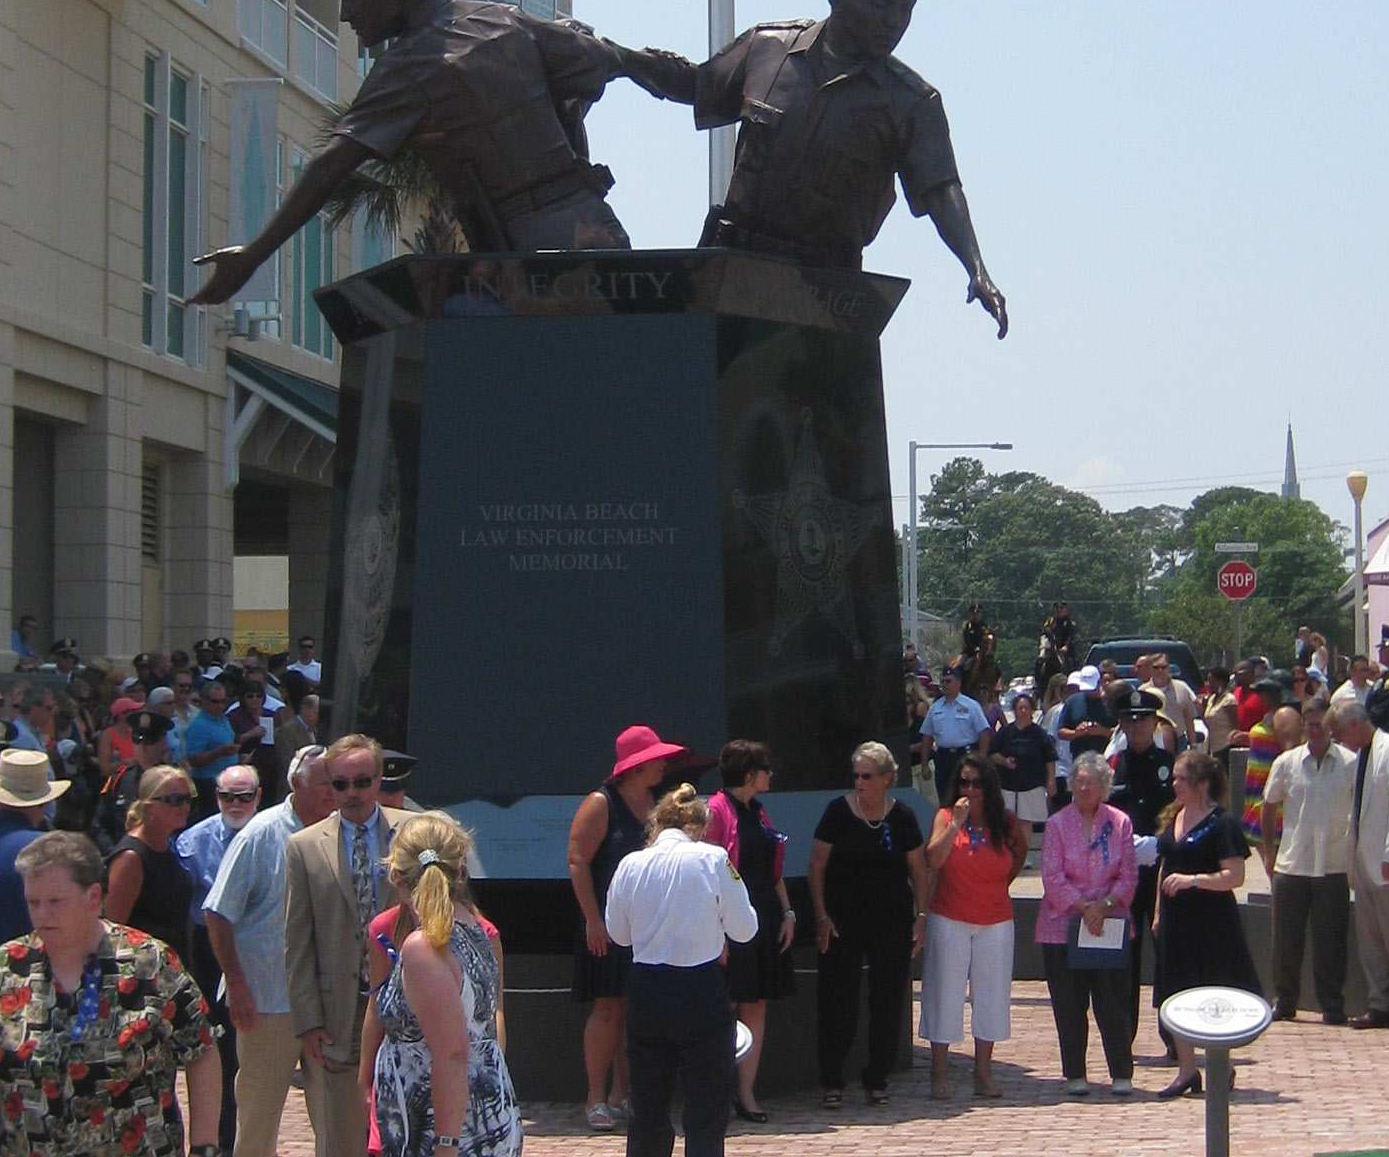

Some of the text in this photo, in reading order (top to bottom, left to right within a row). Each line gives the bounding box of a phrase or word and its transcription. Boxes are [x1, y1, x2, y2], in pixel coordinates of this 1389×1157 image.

[462, 270, 674, 301] INTEGRITY
[480, 503, 659, 521] VIRGINIA BEACH
[461, 528, 679, 546] LAW ENFORCEMENT
[509, 553, 630, 571] MEMORIAL
[1221, 573, 1254, 587] STOP
